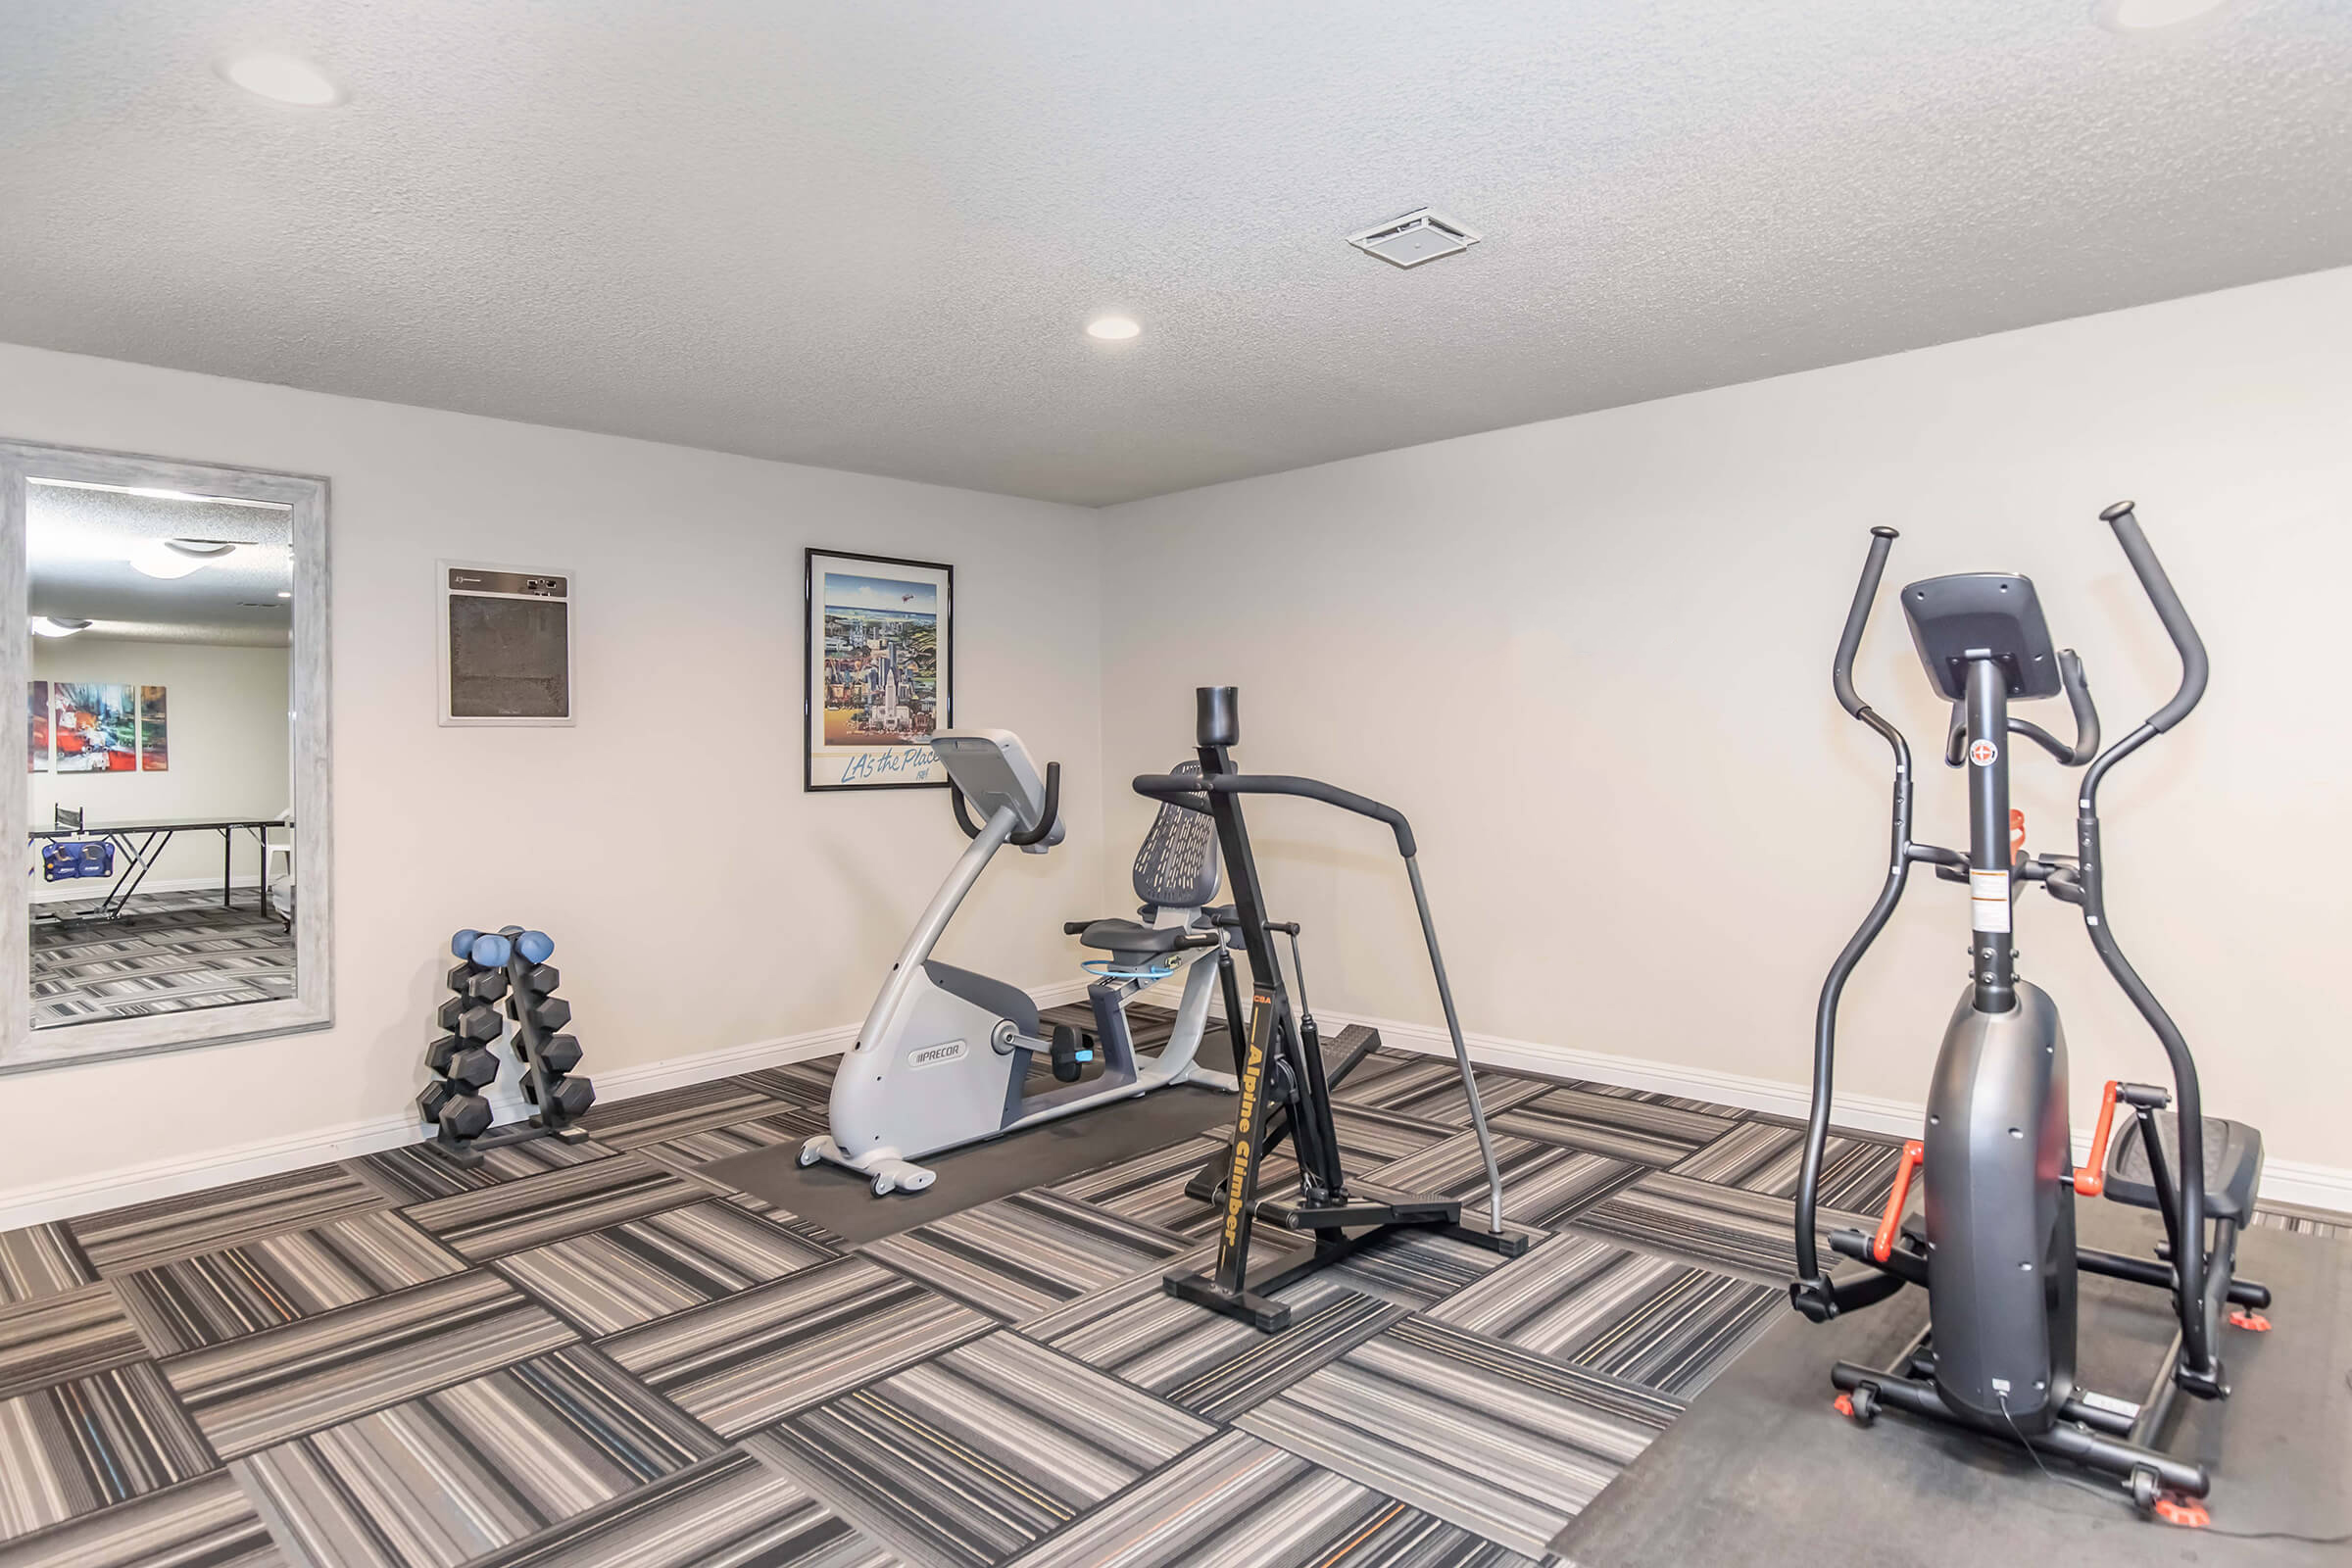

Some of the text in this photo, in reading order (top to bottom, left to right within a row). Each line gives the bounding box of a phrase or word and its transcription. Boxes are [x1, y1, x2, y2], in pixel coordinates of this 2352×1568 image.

[841, 752, 875, 783] LA's
[877, 747, 901, 772] the
[921, 1045, 959, 1061] PRECOR
[1225, 1044, 1262, 1247] Alpine Climber
